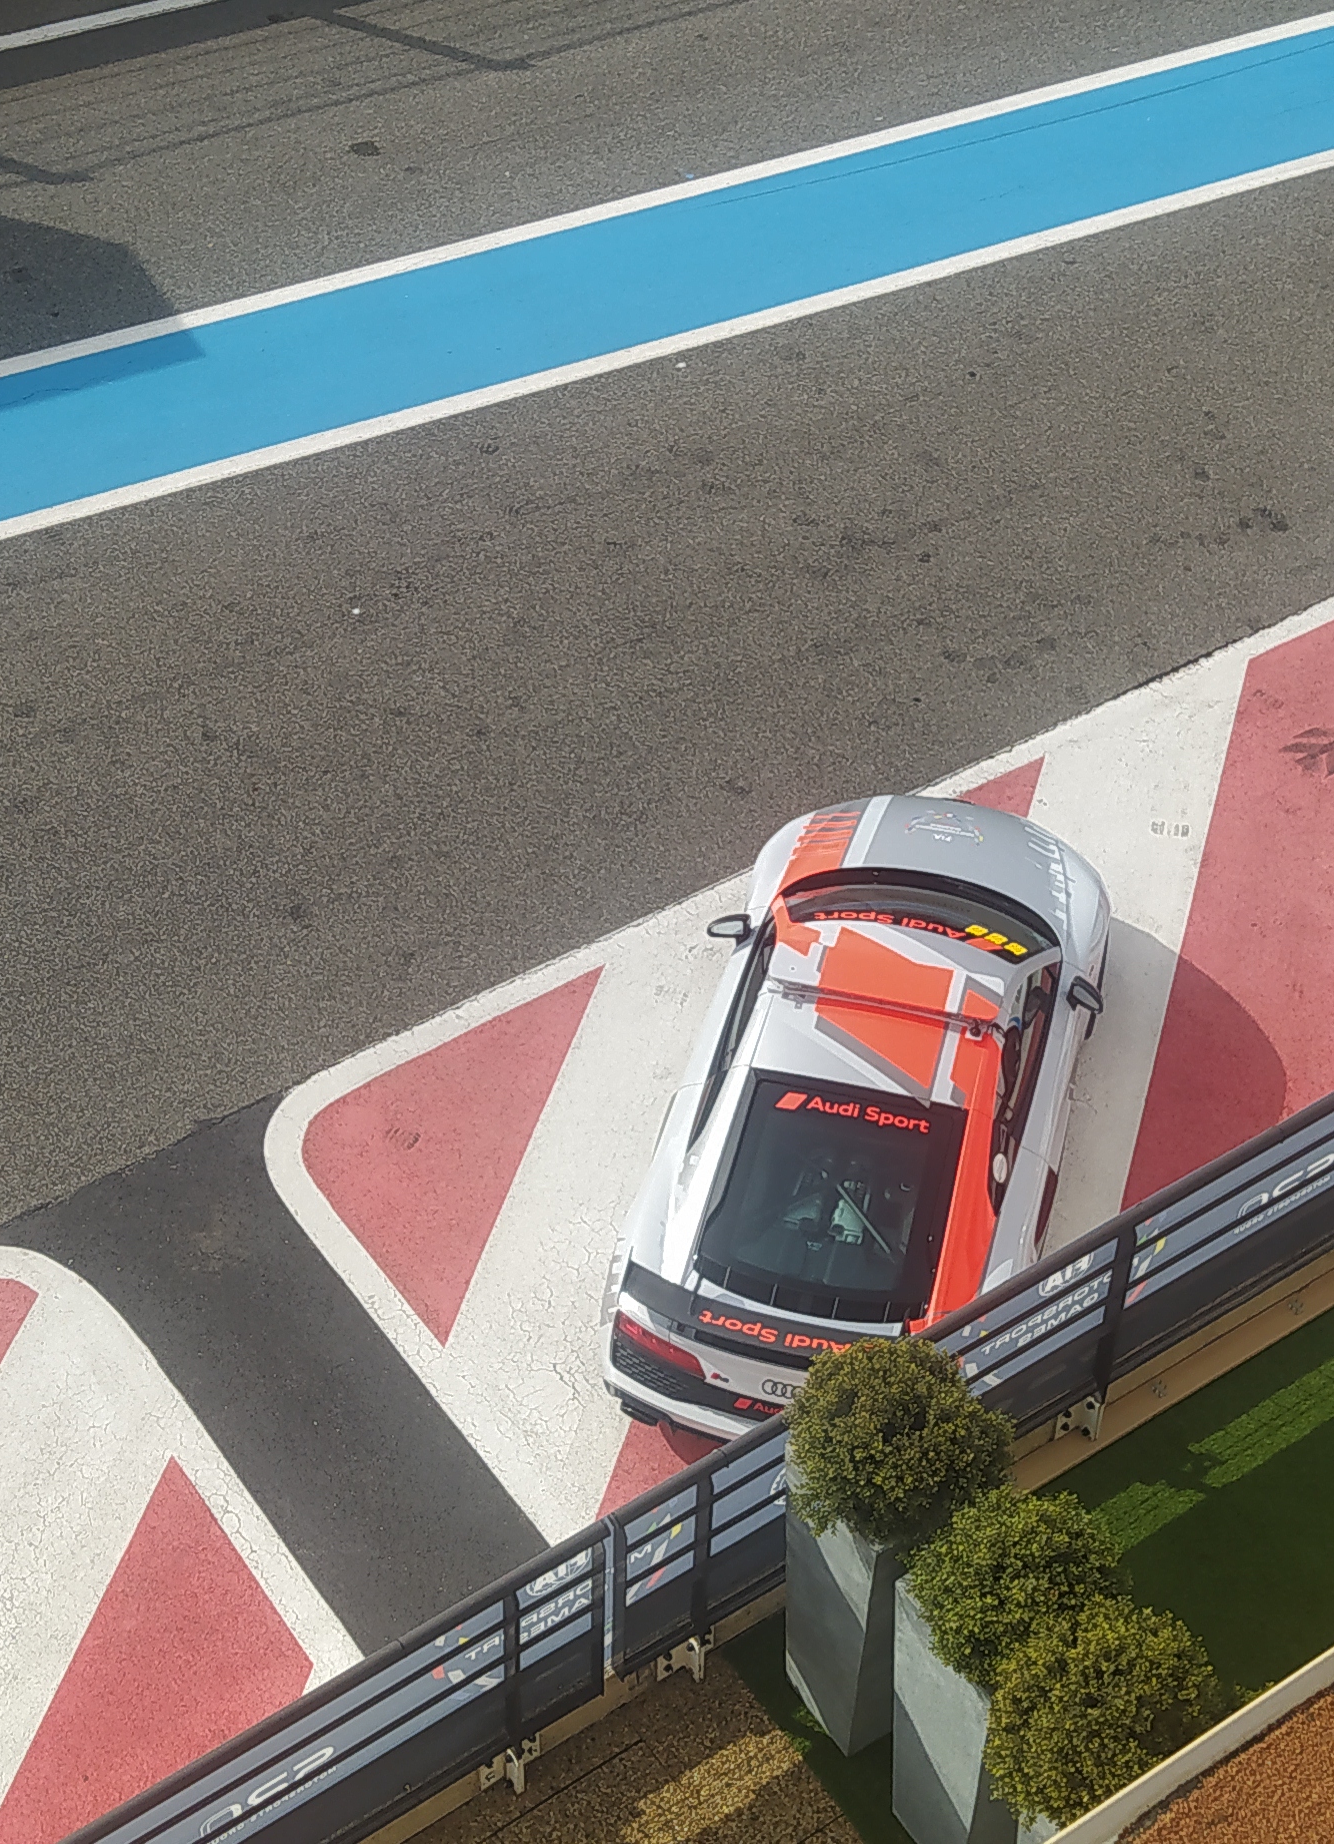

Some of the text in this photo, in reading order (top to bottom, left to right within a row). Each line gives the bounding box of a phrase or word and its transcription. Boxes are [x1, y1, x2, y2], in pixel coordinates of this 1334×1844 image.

[814, 911, 967, 939] Audi Sport
[806, 1096, 930, 1133] Audi Sport
[698, 1309, 778, 1343] Sport
